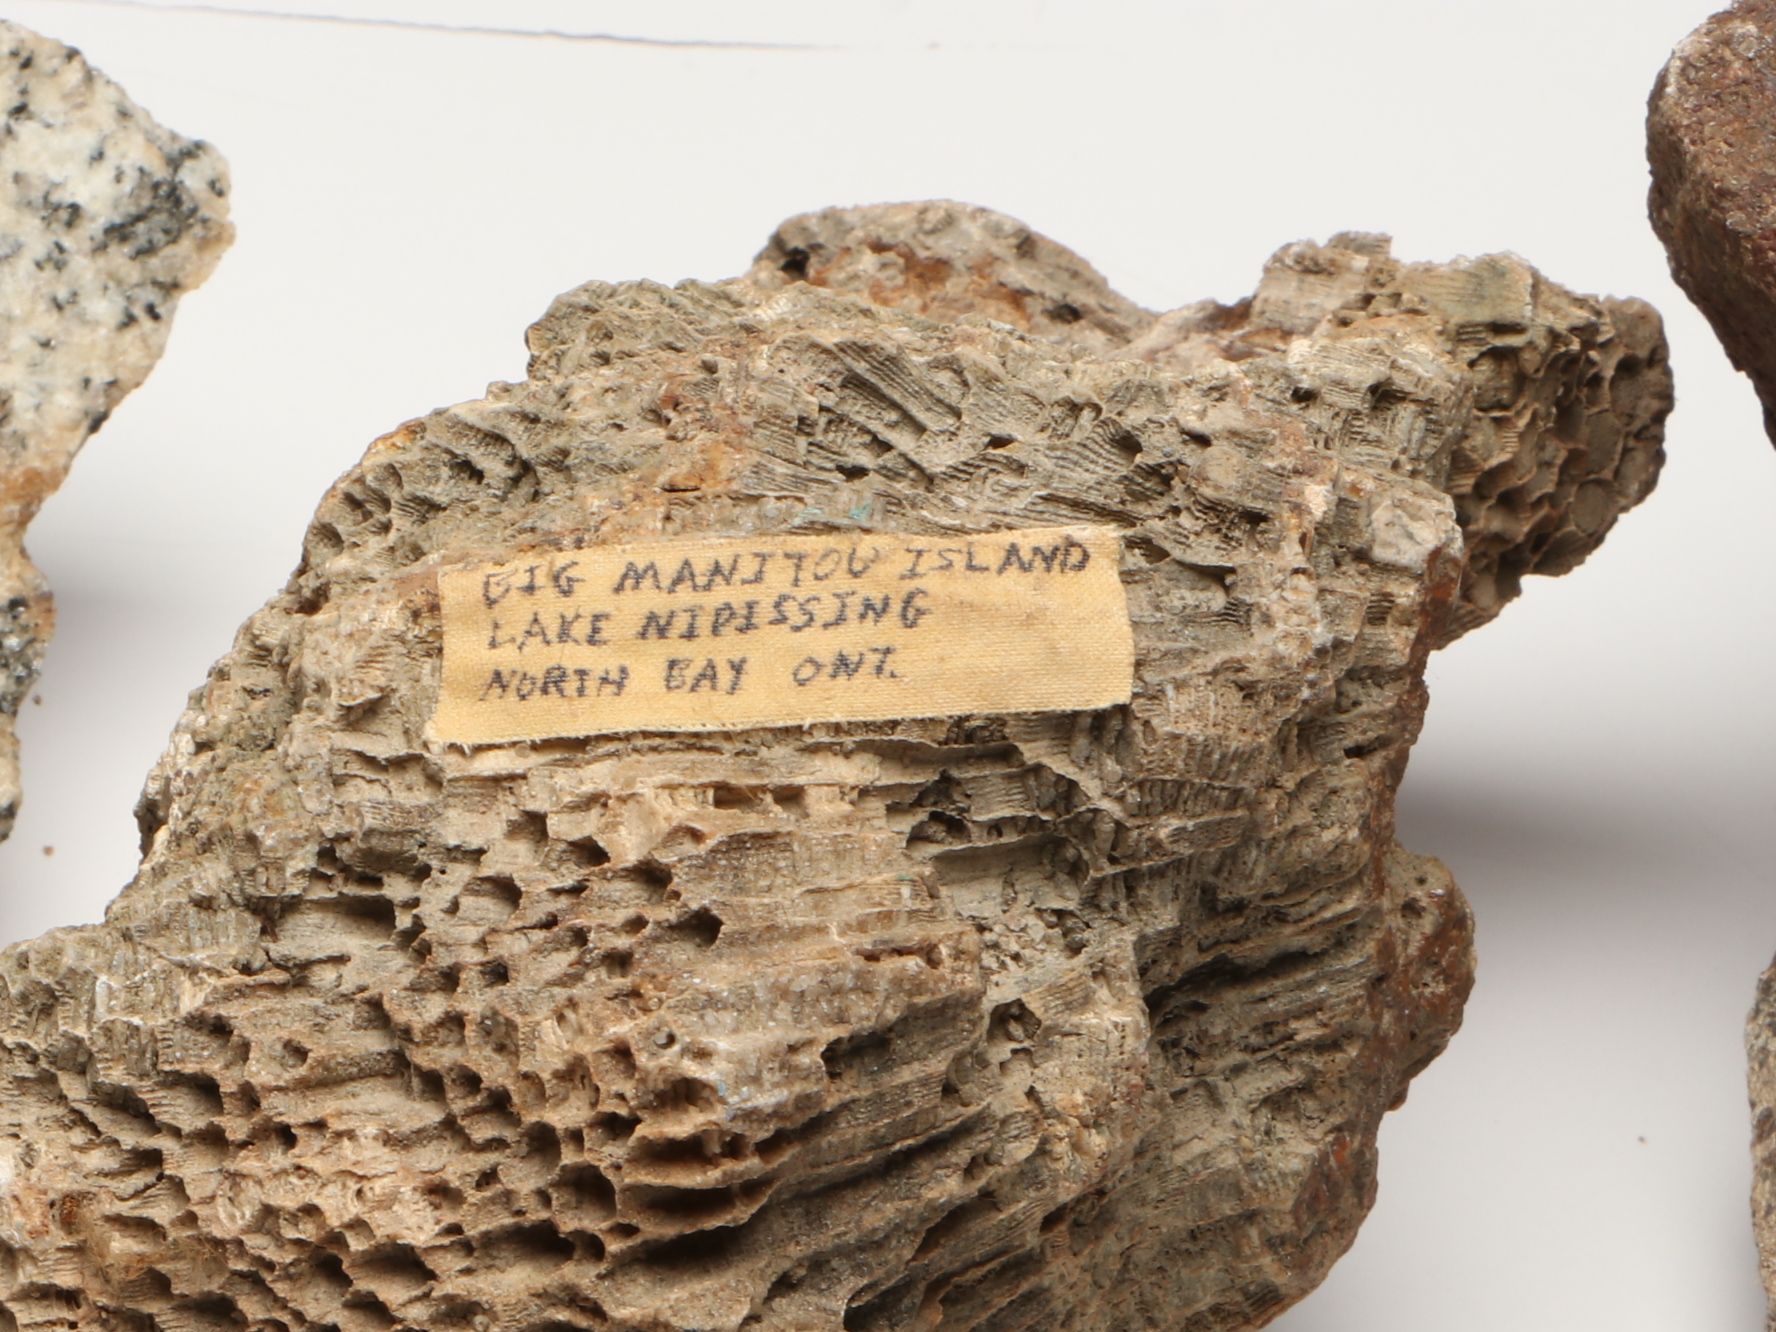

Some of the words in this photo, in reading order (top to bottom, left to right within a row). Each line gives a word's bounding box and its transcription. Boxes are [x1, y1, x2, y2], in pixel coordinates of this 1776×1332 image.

[481, 559, 586, 608] BIG
[613, 546, 880, 596] MANITOU
[898, 534, 1092, 581] ISLAND
[487, 613, 612, 653] LAKE
[636, 589, 931, 641] NIPISSING
[479, 665, 630, 701] NORTH
[664, 656, 749, 696] BAY
[792, 647, 899, 686] ONT.
